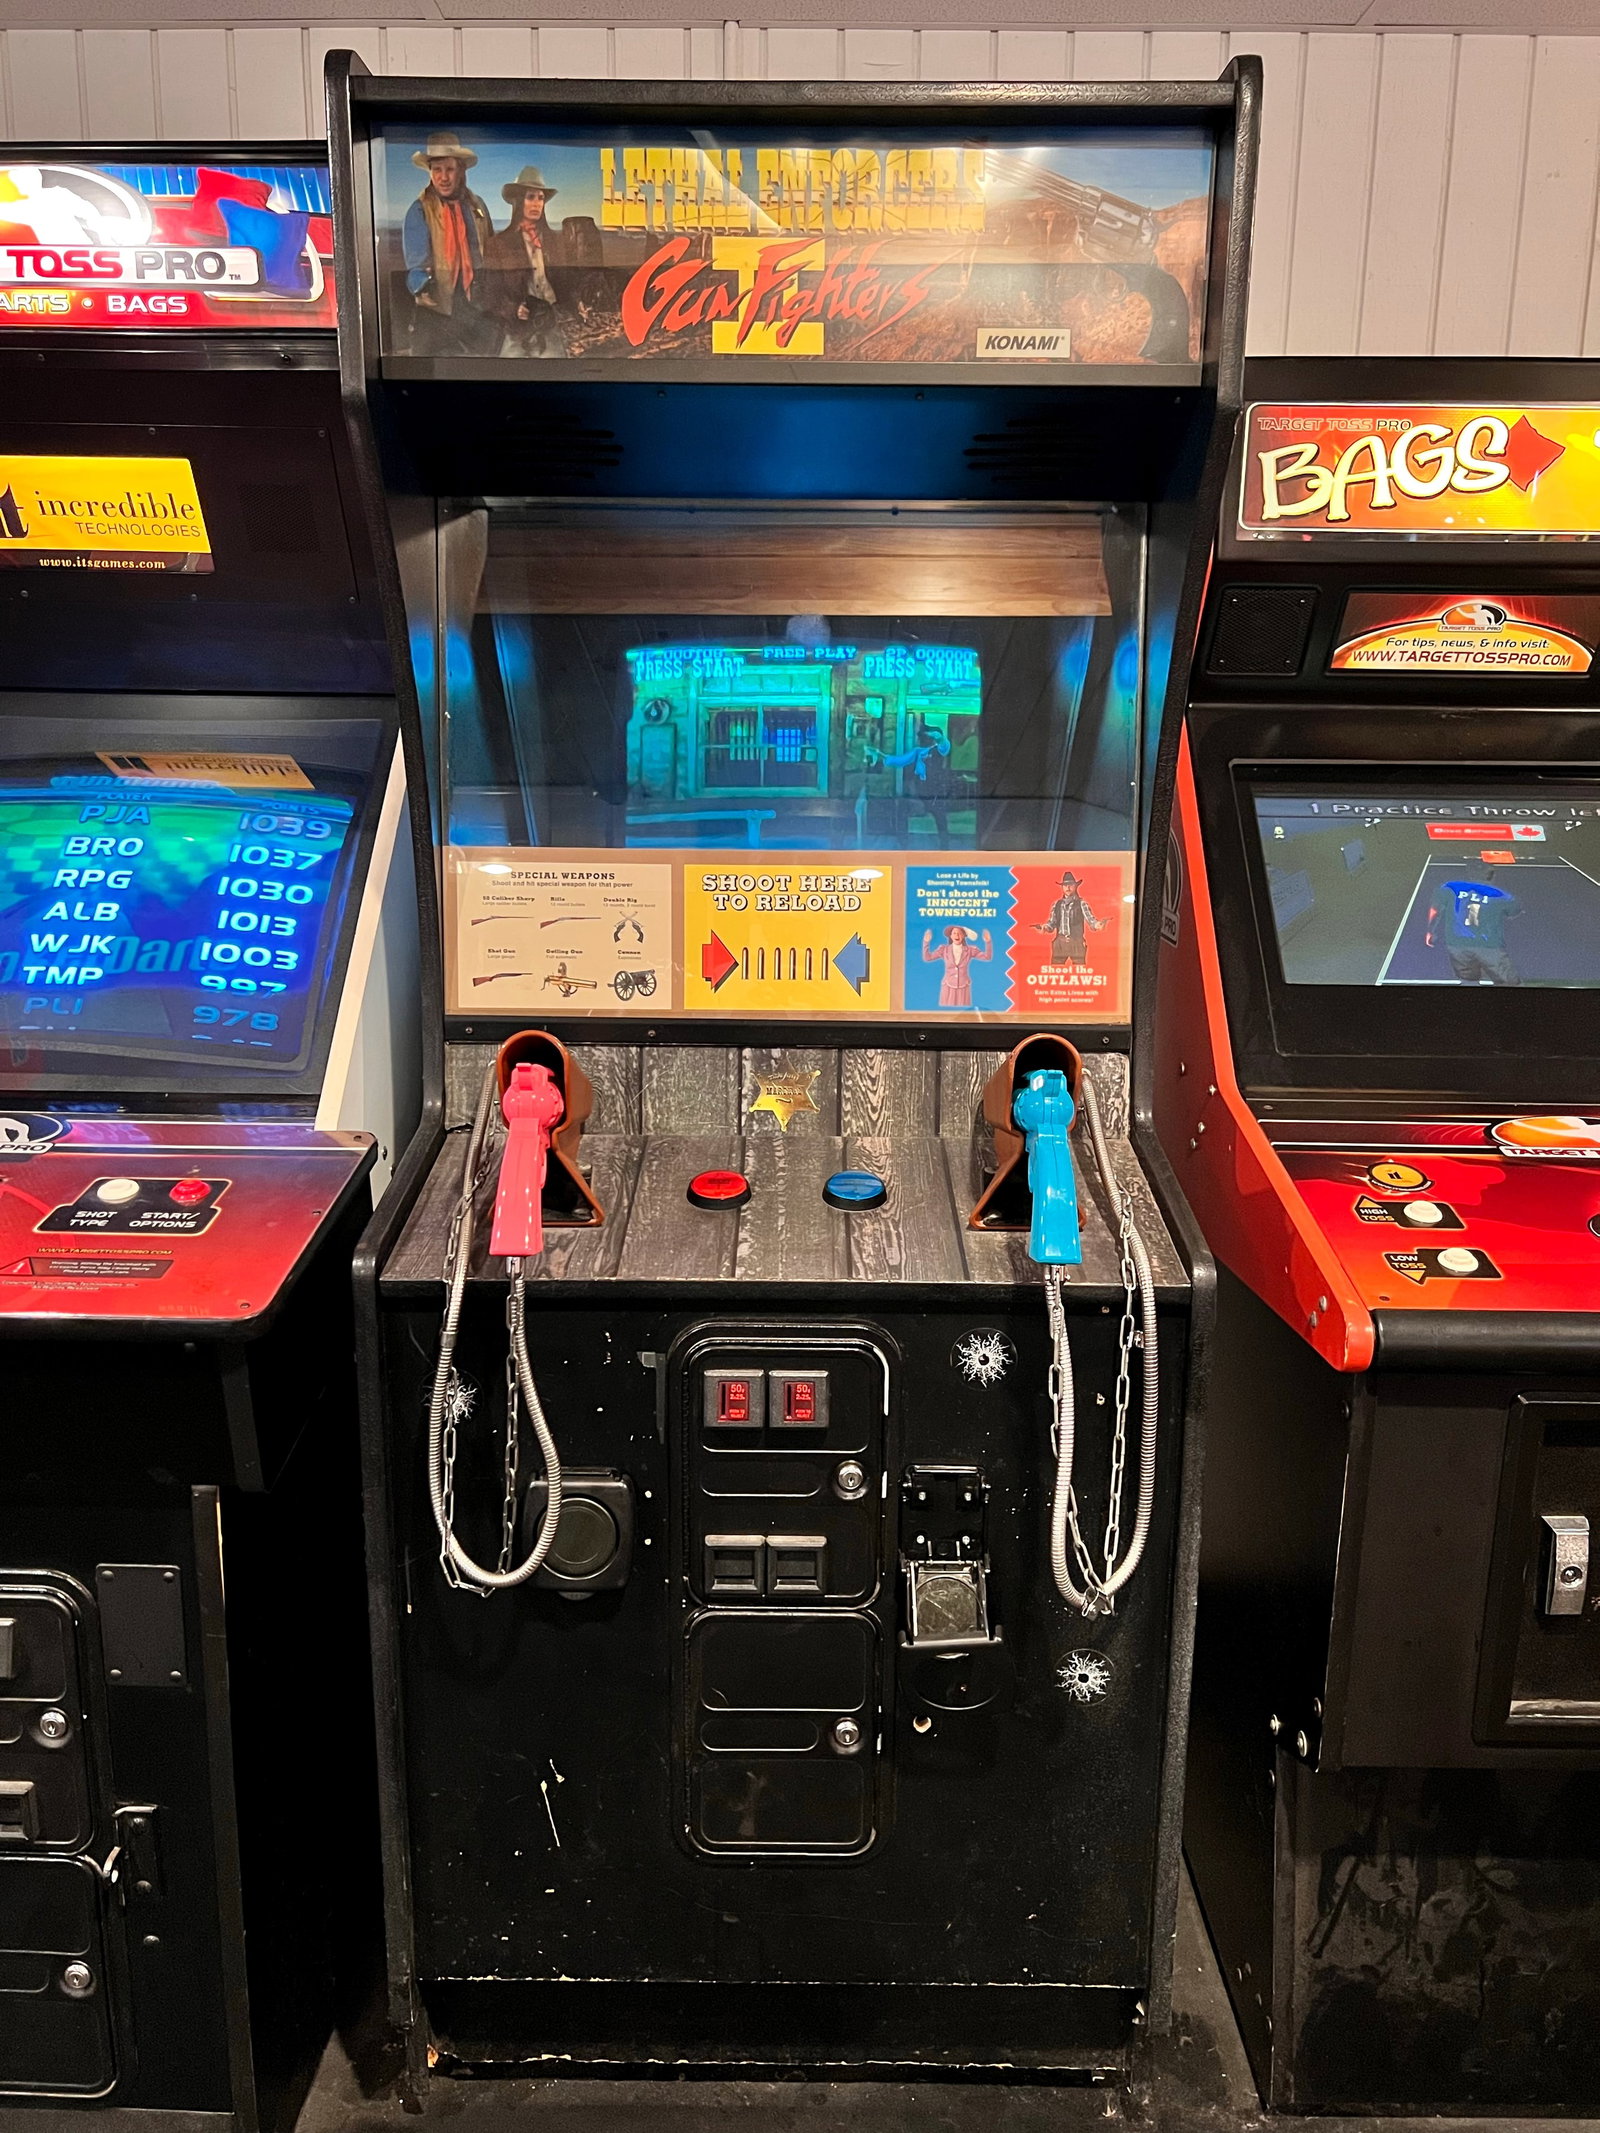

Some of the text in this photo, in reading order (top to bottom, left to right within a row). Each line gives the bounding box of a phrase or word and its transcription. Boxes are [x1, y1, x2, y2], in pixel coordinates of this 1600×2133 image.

[600, 147, 986, 232] LETHAL ENFORCERS
[7, 249, 123, 279] TOSS
[135, 251, 226, 280] PRO
[107, 295, 188, 314] BAGS
[985, 335, 1061, 350] KONAMI
[1258, 418, 1412, 431] TARGET TOSS PRO
[1258, 416, 1510, 522] BAGS
[35, 490, 196, 521] incredible
[75, 521, 201, 538] TECHNOLOGIES
[39, 556, 166, 570] www.itsgames.com
[1386, 637, 1550, 649] For tips, news, & info visit:
[814, 647, 857, 660] PLAY
[1353, 650, 1572, 667] WWW.TARGETTOSSPRO.COM
[636, 657, 745, 681] PRESS START
[864, 656, 974, 679] PRESS START
[97, 792, 321, 815] PLAYER POINTS
[1310, 803, 1319, 814] 1
[1332, 803, 1453, 815] Practice
[1464, 806, 1556, 816] Throw
[79, 805, 332, 839] PJA 1039
[64, 836, 323, 870] BRO 1037
[511, 872, 616, 880] SPECIAL WEAPONS
[702, 874, 871, 892] SHOOT HERE
[971, 872, 979, 880] by
[53, 869, 314, 905] RPG 1030
[537, 881, 560, 889] special
[916, 888, 1000, 898] Don't shoot the
[713, 894, 861, 912] TO RELOAD
[926, 898, 989, 907] INNOCENT
[42, 902, 297, 937] ALB 1013
[918, 908, 997, 917] TOWNSFOLK!
[1164, 915, 1177, 936] PRO
[30, 933, 299, 971] WJK 1003
[1041, 965, 1094, 974] Shoot the
[23, 966, 103, 986] TMP
[200, 974, 287, 999] 997
[1026, 974, 1107, 986] OUTLAWS!
[193, 1005, 279, 1031] 978
[1504, 1148, 1586, 1156] TARGET
[69, 1219, 110, 1227] TYPE
[75, 1210, 118, 1219] SHOT
[141, 1212, 200, 1220] START/
[129, 1220, 197, 1228] OPTIONS
